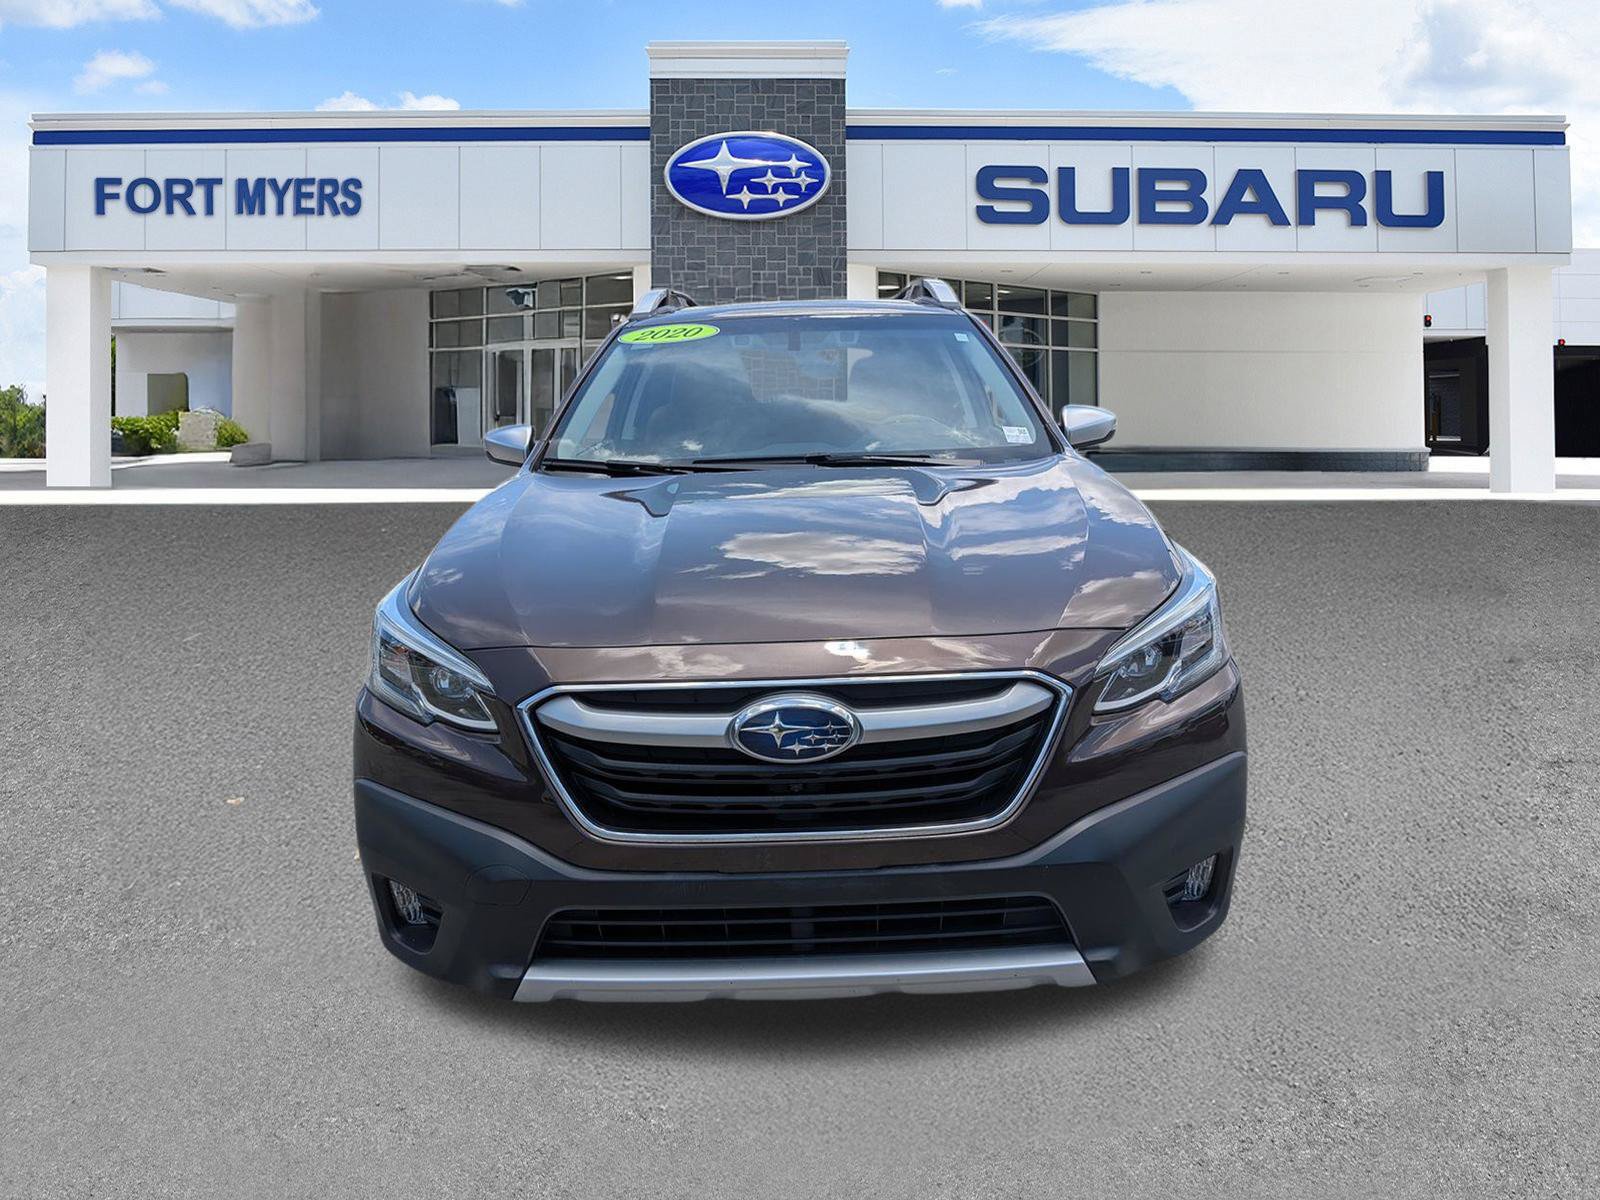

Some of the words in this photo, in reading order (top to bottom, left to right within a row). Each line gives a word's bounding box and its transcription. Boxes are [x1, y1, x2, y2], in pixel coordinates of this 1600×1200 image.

[94, 177, 223, 216] FORT
[235, 177, 363, 216] MYERS
[975, 165, 1445, 228] SUBARU
[633, 327, 703, 341] 2020
